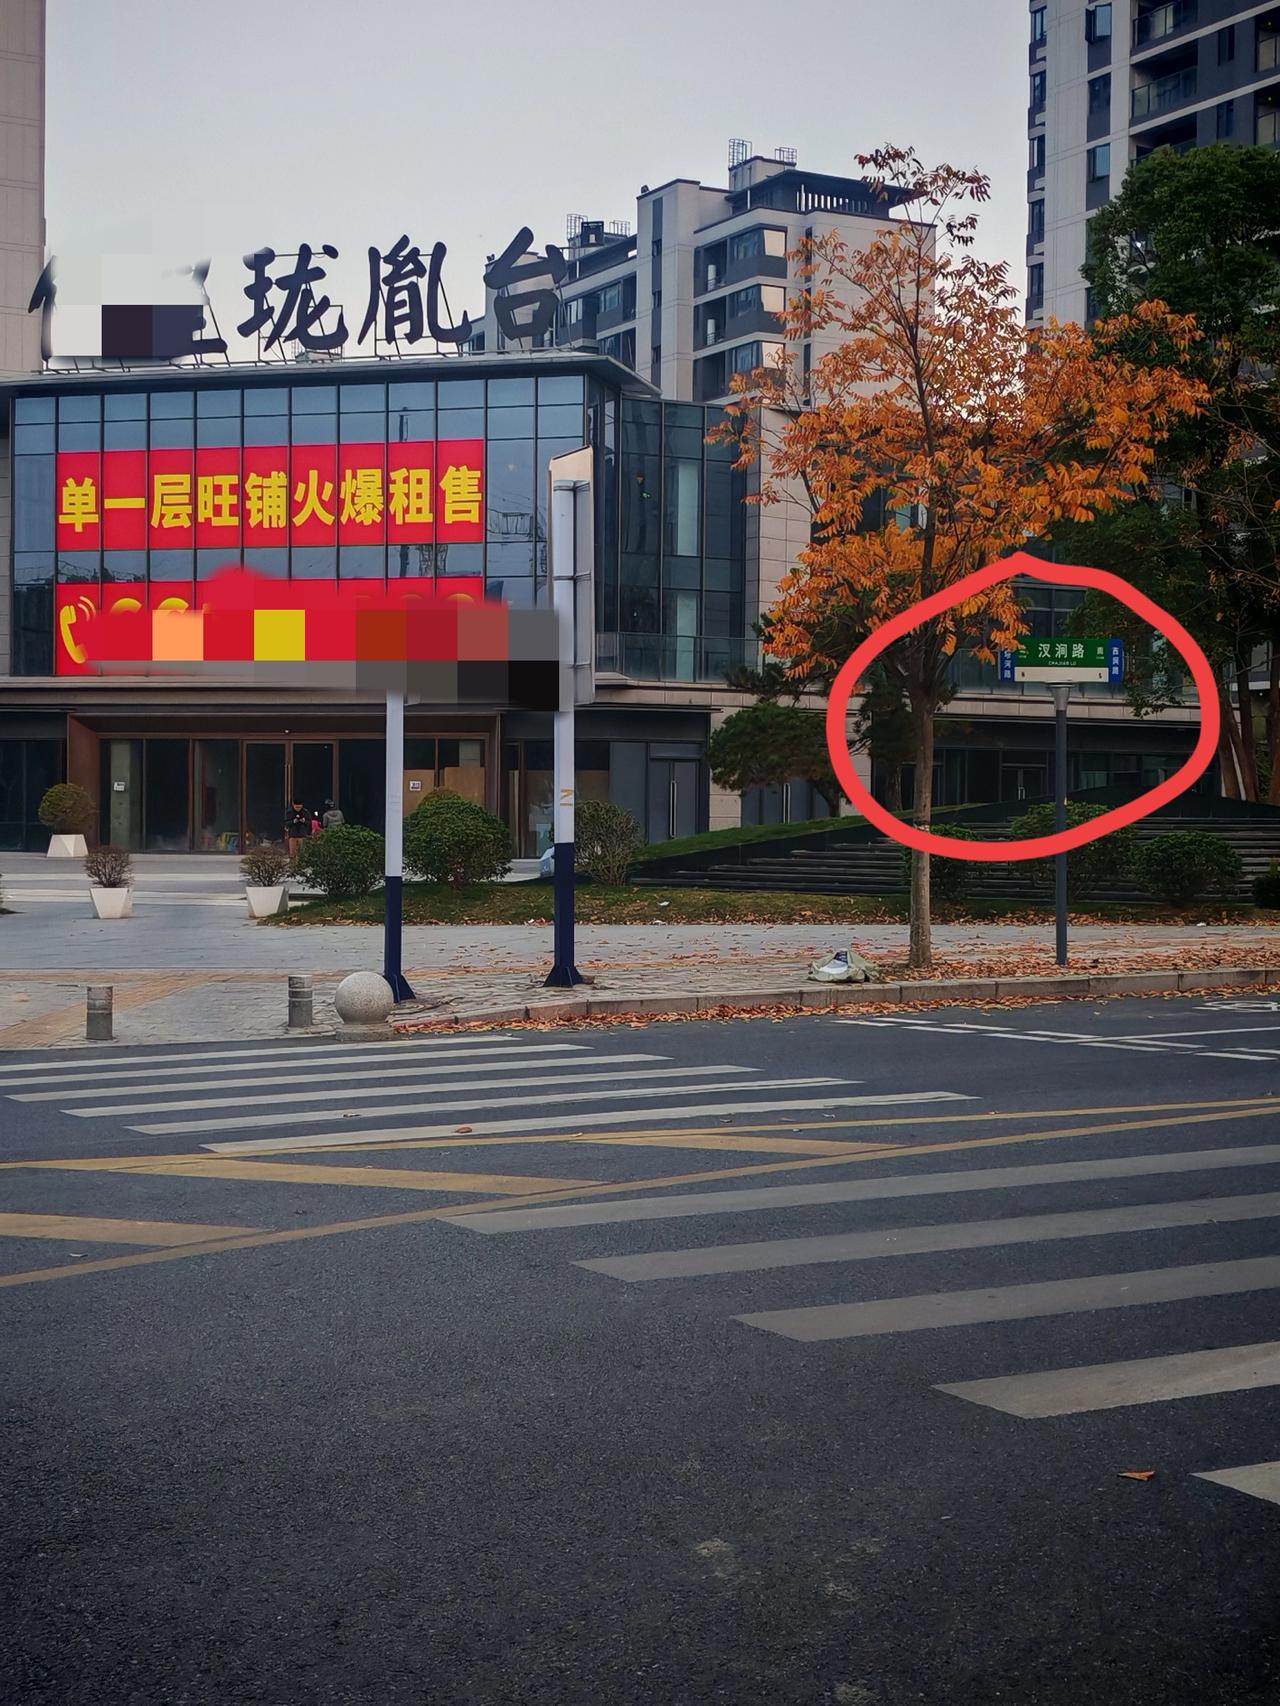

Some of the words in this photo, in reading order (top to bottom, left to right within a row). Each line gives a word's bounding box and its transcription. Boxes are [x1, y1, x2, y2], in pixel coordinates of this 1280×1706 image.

[58, 465, 482, 532] 单一层旺铺火爆租售
